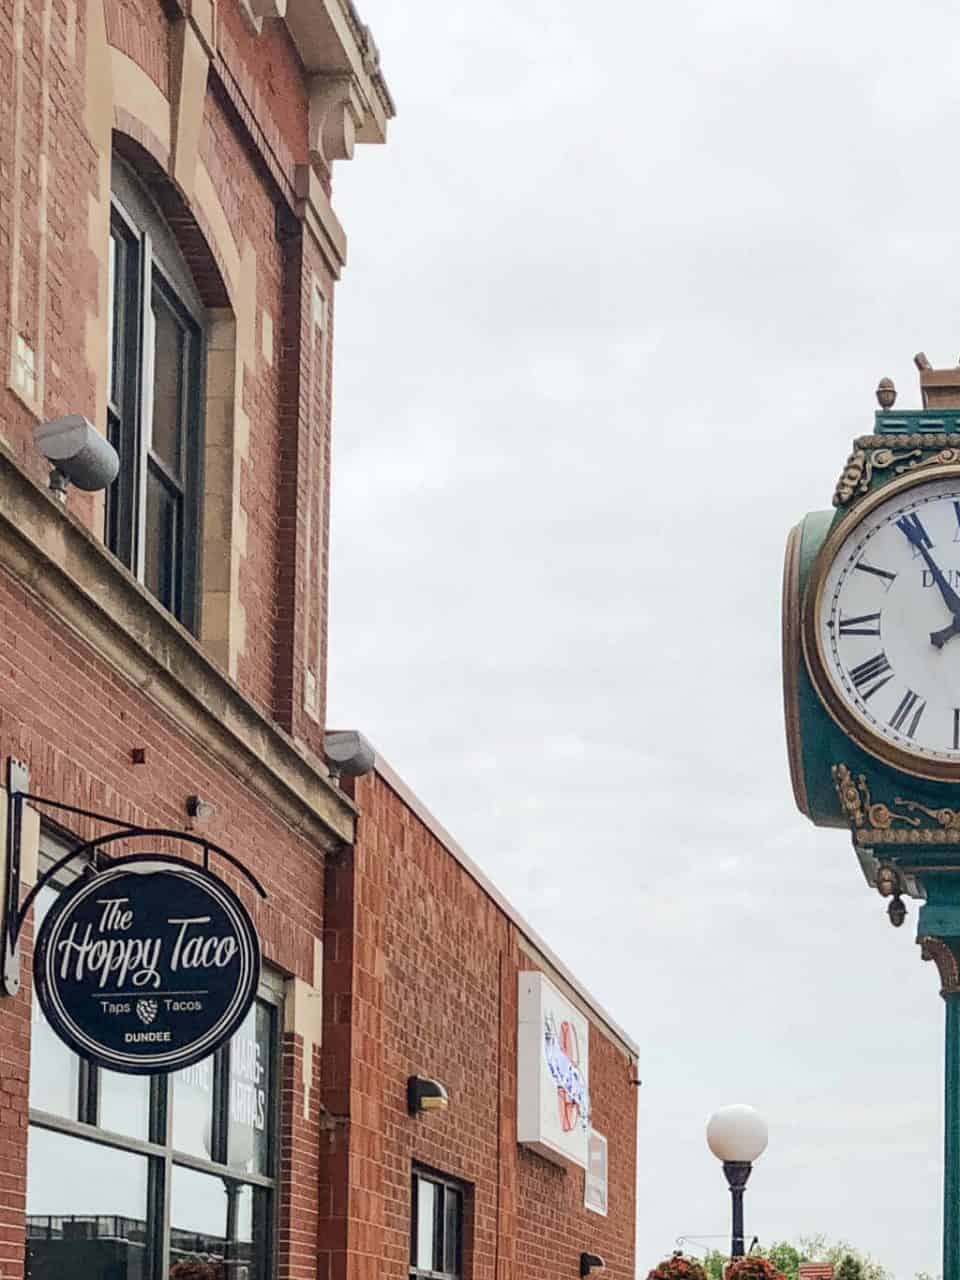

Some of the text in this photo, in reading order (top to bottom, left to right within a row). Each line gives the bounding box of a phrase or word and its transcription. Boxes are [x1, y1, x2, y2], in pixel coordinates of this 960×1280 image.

[96, 897, 133, 933] The
[58, 915, 239, 988] Hoppy Taco
[100, 999, 202, 1014] Taps Tacos
[124, 1031, 171, 1043] DUNDEE
